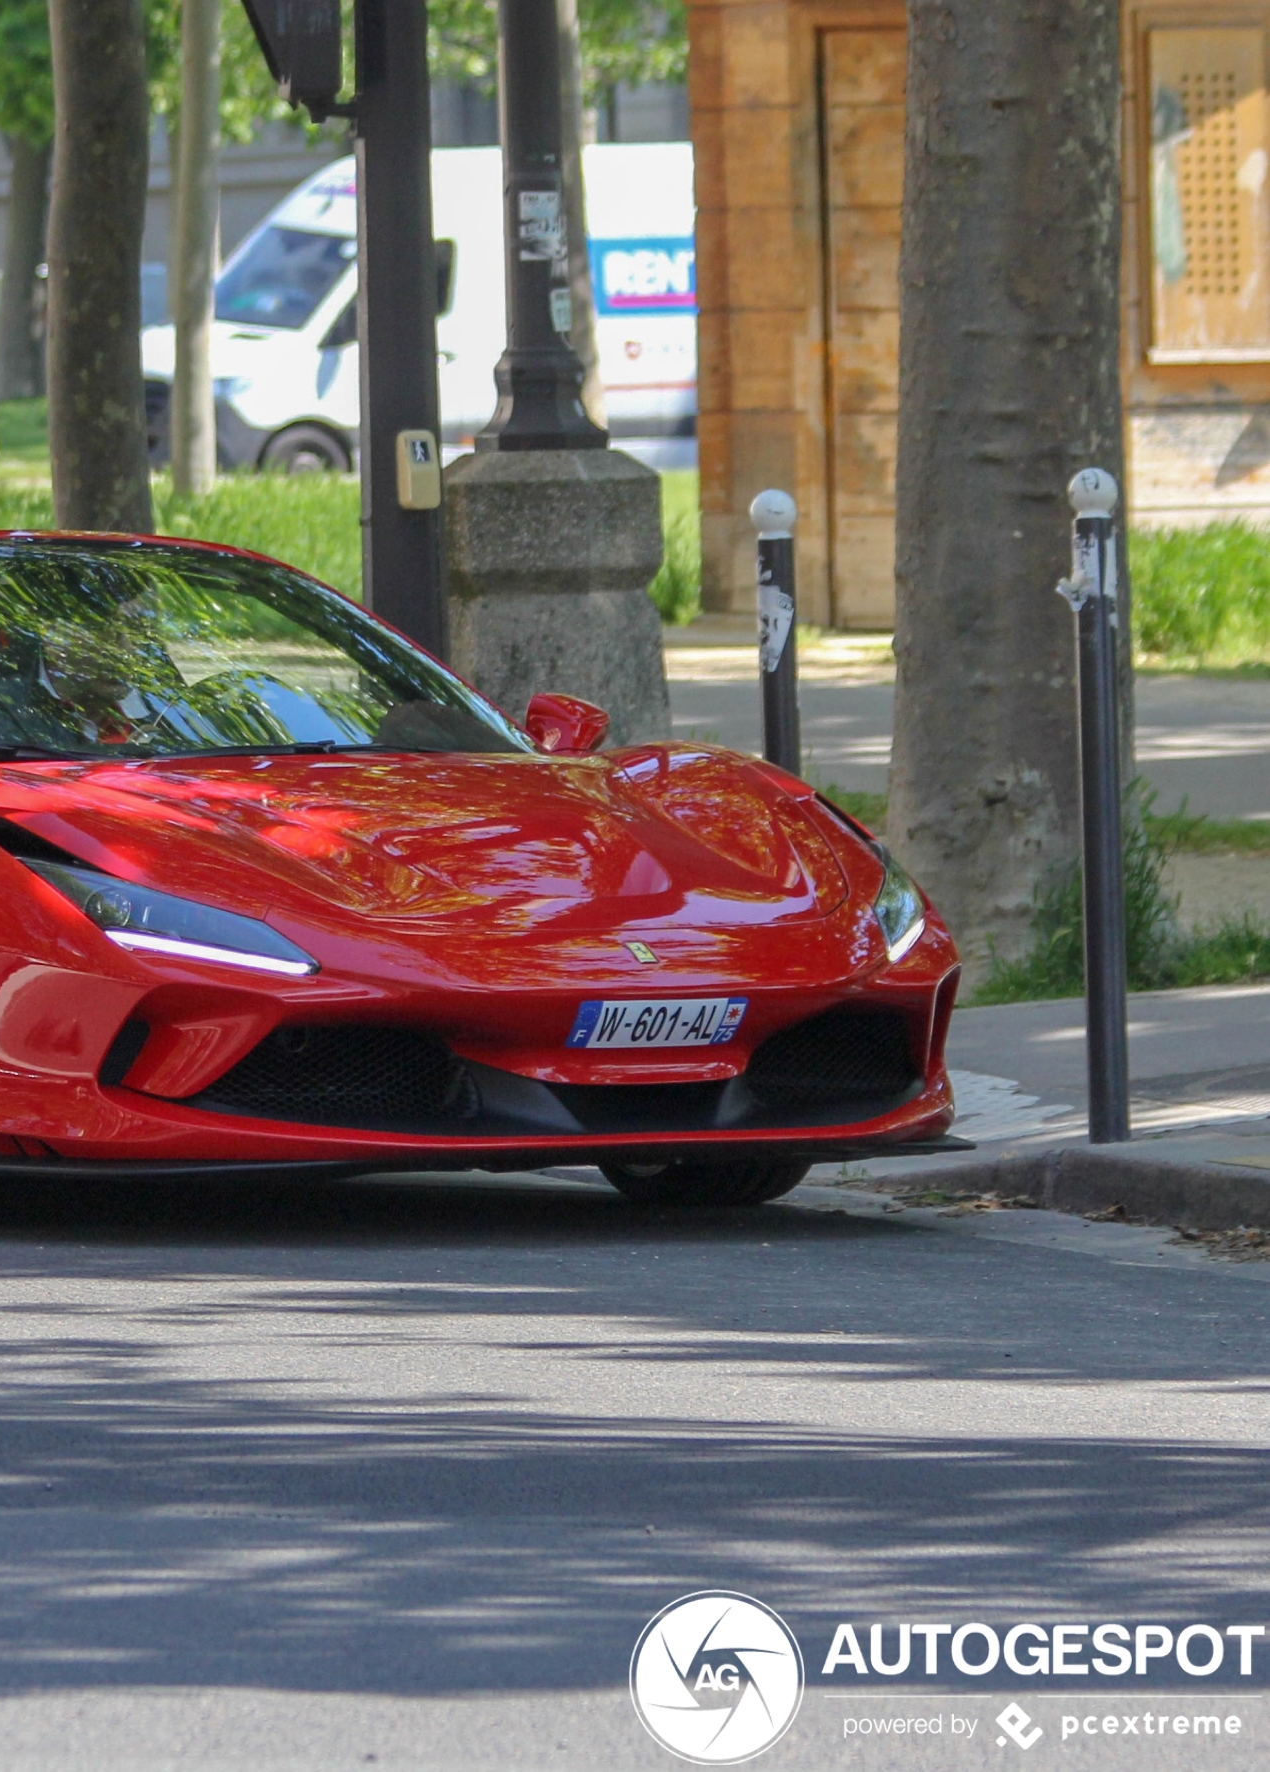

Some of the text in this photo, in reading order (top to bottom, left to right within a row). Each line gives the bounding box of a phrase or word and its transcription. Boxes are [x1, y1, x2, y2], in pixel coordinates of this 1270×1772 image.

[603, 250, 695, 295] REN
[573, 1030, 586, 1042] F
[597, 1006, 717, 1042] W-601-AL
[714, 1028, 735, 1042] 75
